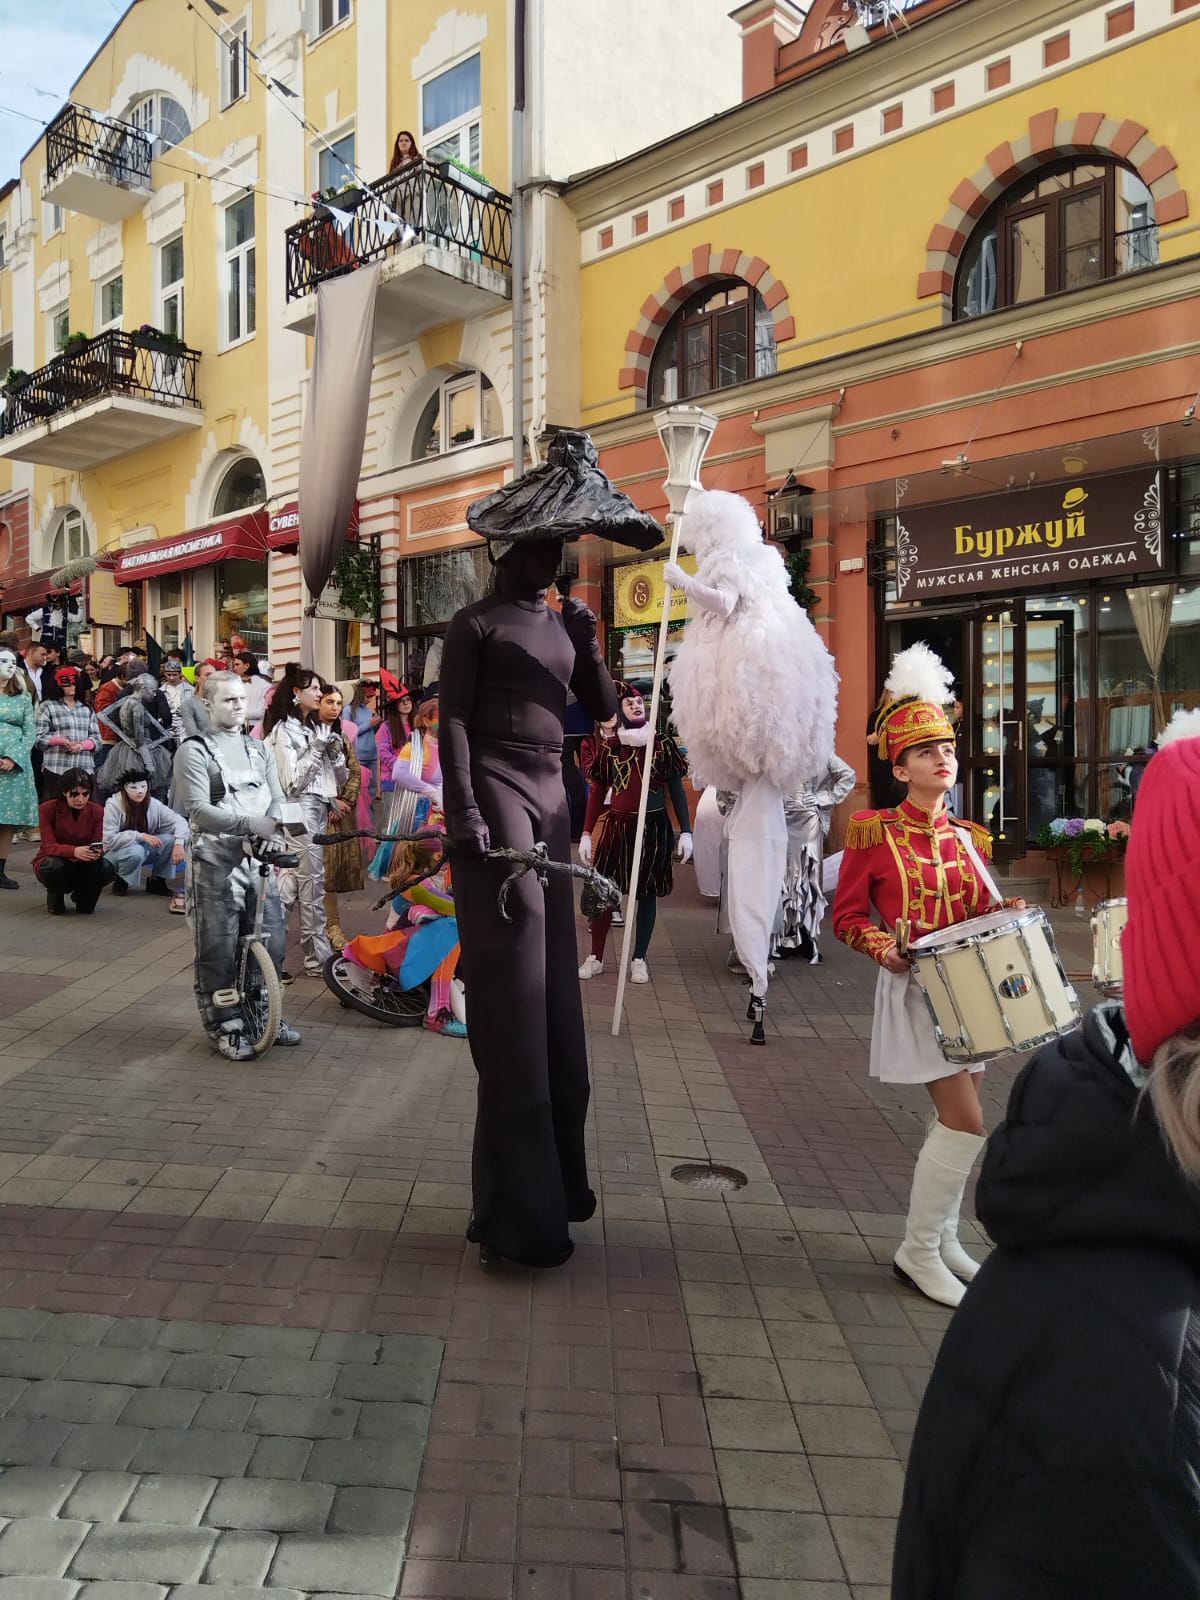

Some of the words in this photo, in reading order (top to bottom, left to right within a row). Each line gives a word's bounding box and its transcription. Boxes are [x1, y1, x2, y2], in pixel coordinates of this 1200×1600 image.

[121, 546, 175, 569] НАТУРАЛЬНАЯ
[175, 533, 223, 555] КОСМЕТИКА
[954, 509, 1086, 558] Буржуй
[916, 570, 983, 588] МУЖСКАЯ
[991, 560, 1060, 579] ЖЕНСКАЯ
[1068, 550, 1137, 569] ОДЕЖДА
[656, 597, 688, 608] ИЗЕЛИЯ
